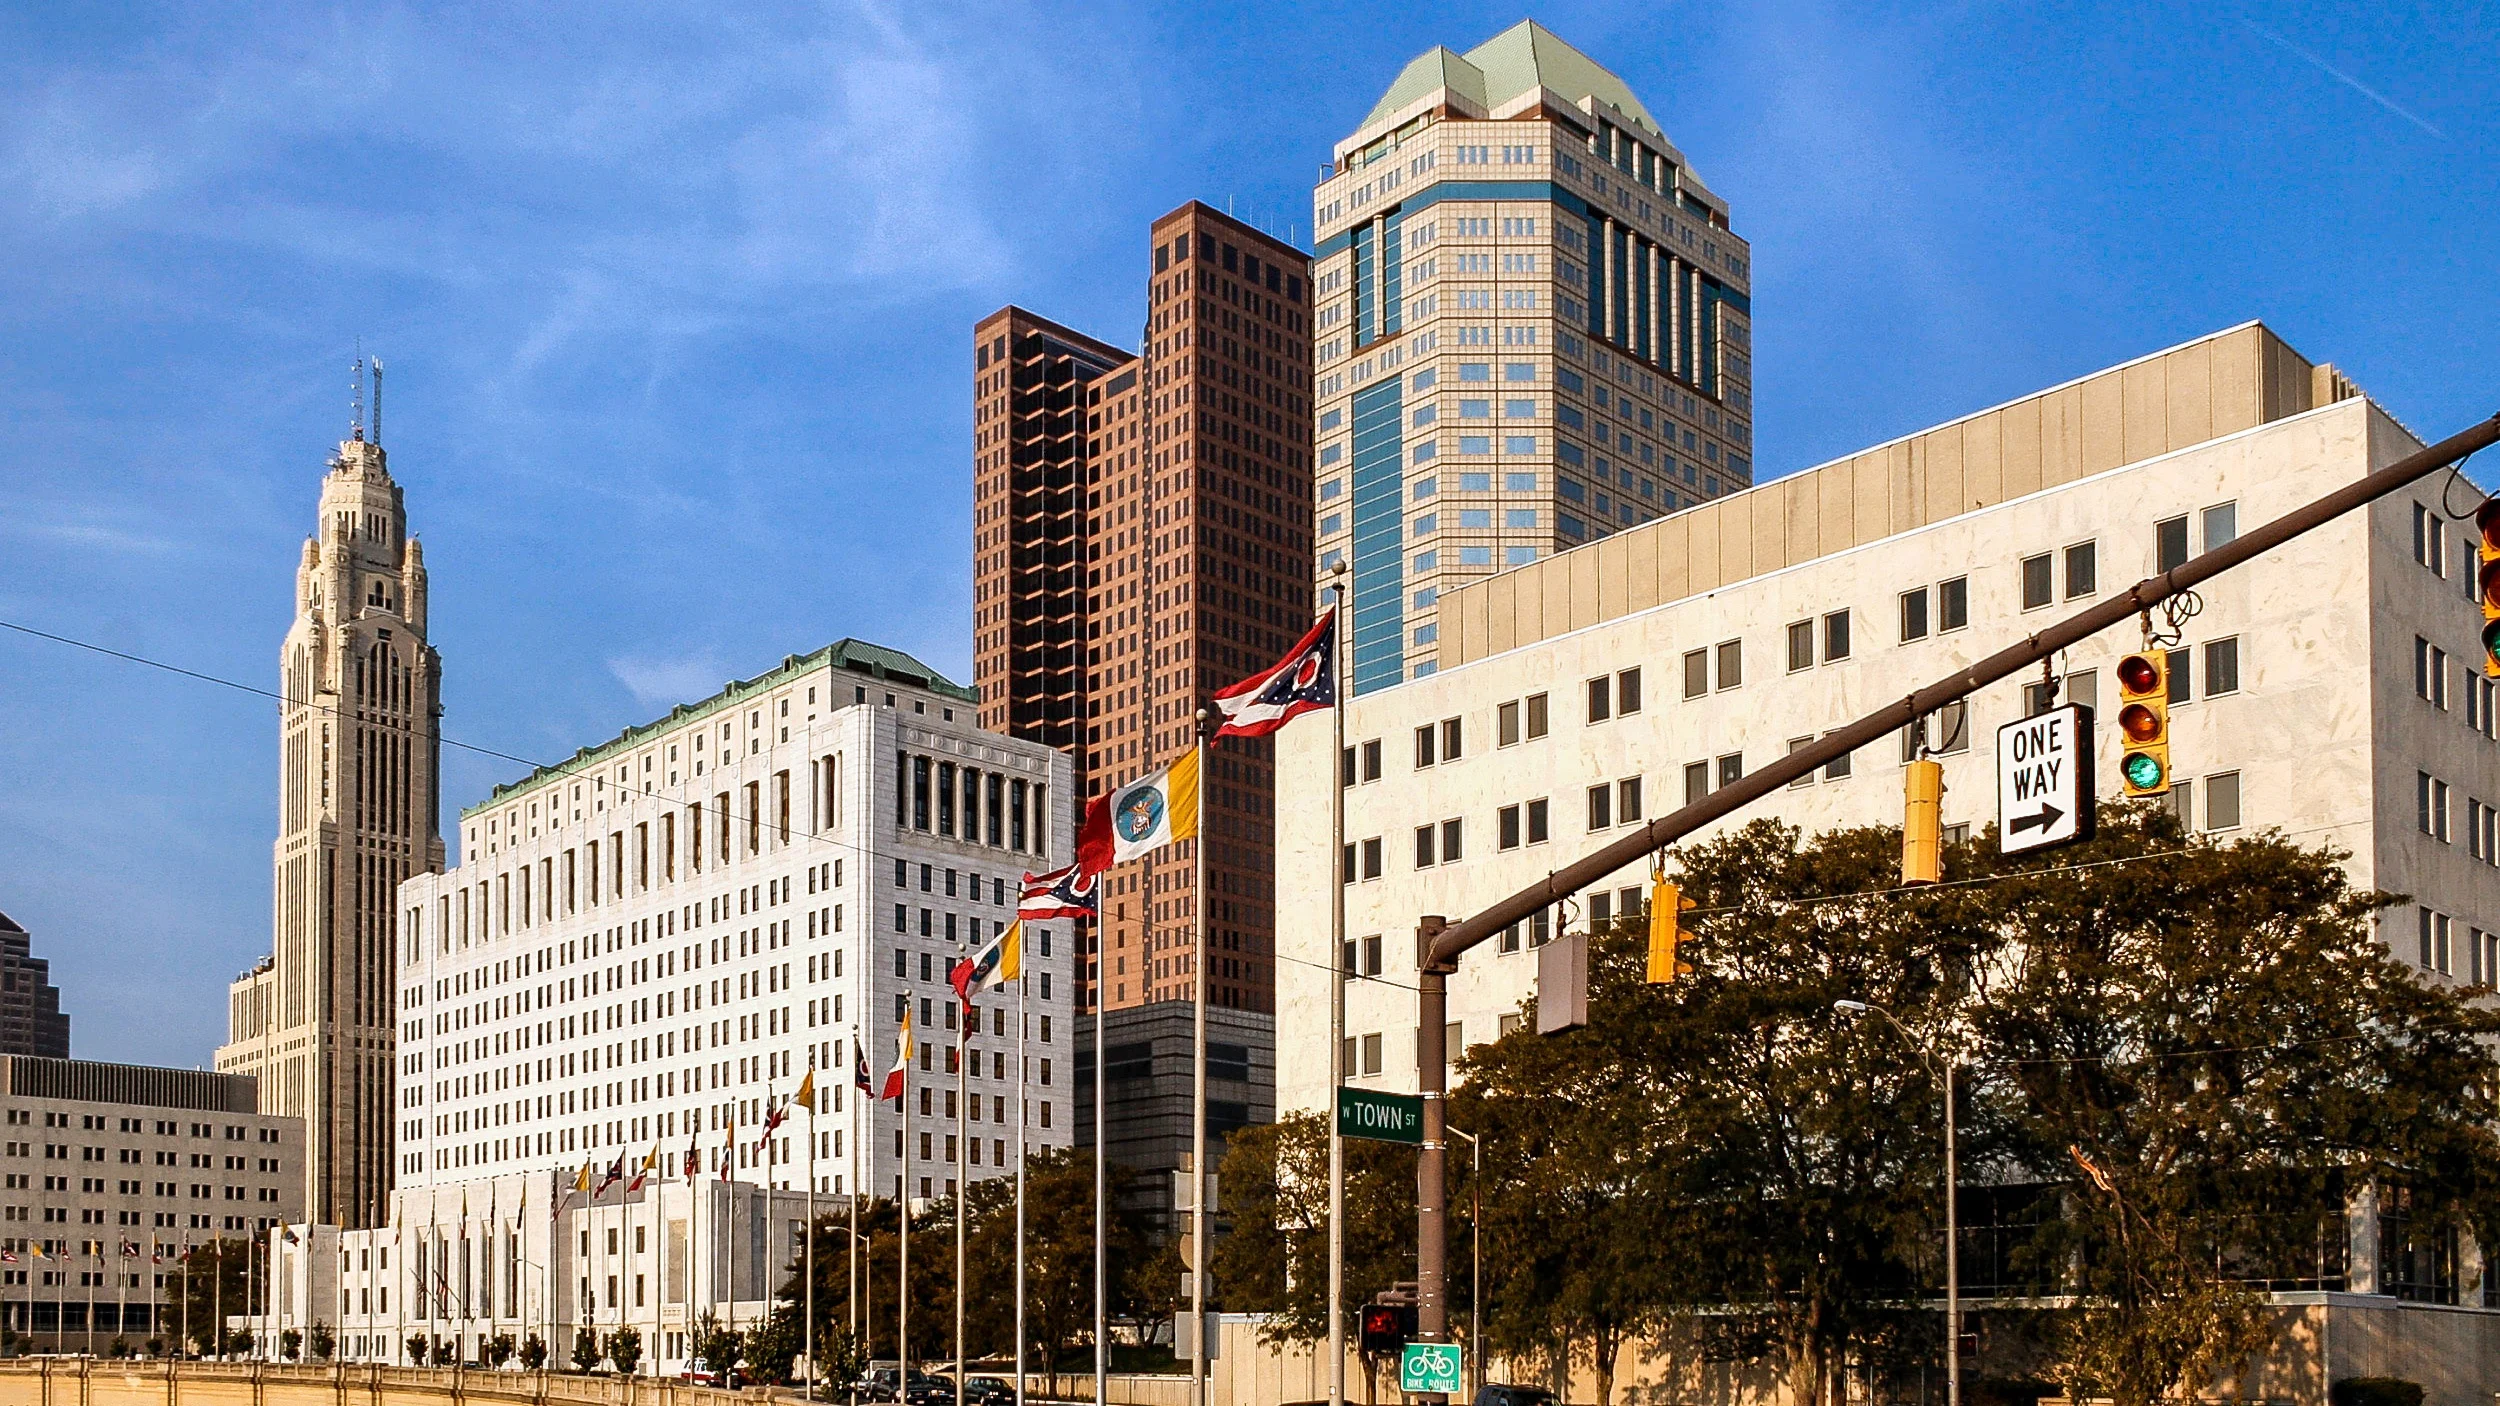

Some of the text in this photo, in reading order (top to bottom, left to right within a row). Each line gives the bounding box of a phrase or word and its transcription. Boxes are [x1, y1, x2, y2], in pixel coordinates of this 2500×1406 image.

[2013, 718, 2063, 763] ONE
[2013, 757, 2062, 802] WAY
[1343, 1101, 1415, 1130] W TOWN ST
[1406, 1378, 1455, 1390] BIKE ROUTE
